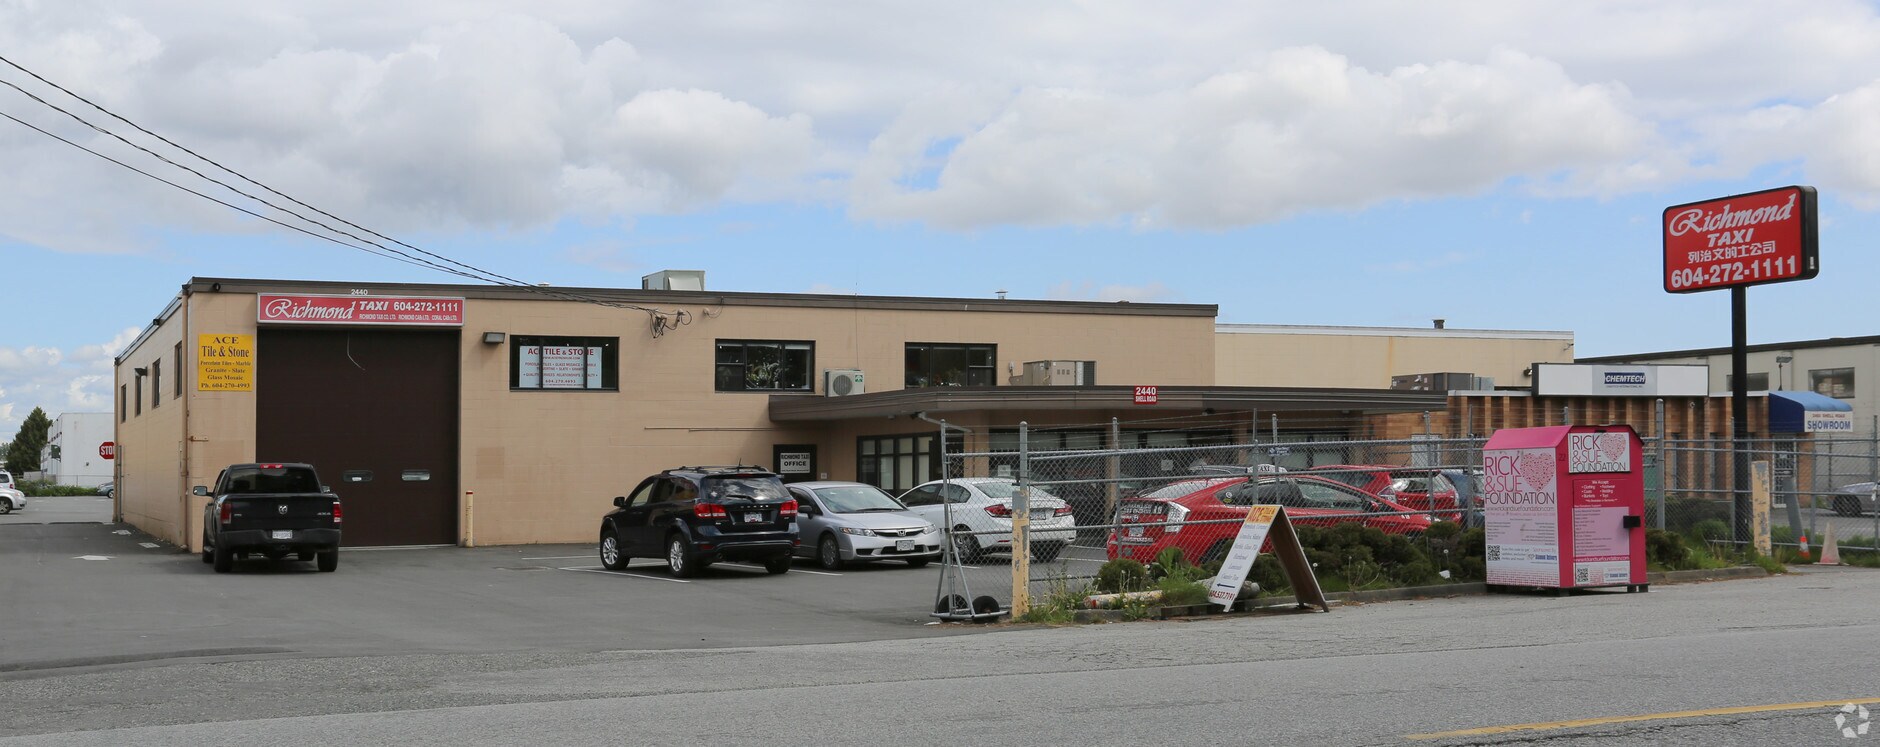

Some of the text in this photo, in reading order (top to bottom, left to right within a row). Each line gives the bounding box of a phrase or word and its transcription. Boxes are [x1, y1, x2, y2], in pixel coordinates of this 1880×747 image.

[1670, 193, 1796, 237] Richmond
[1708, 228, 1754, 248] TAXI
[1688, 241, 1776, 264] 列治文的士公司
[1671, 256, 1796, 288] 604-272-1111
[265, 298, 458, 318] Richmond TAXI 604-272-1111
[202, 346, 249, 357] Tile & Stone
[1136, 387, 1156, 395] 2440
[1807, 421, 1851, 429] SHOWROOM
[1572, 435, 1600, 450] RICK
[101, 446, 114, 455] STO
[1485, 456, 1520, 476] RICK
[1572, 462, 1626, 472] FOUNDATION
[1485, 492, 1555, 506] FOUNDATION
